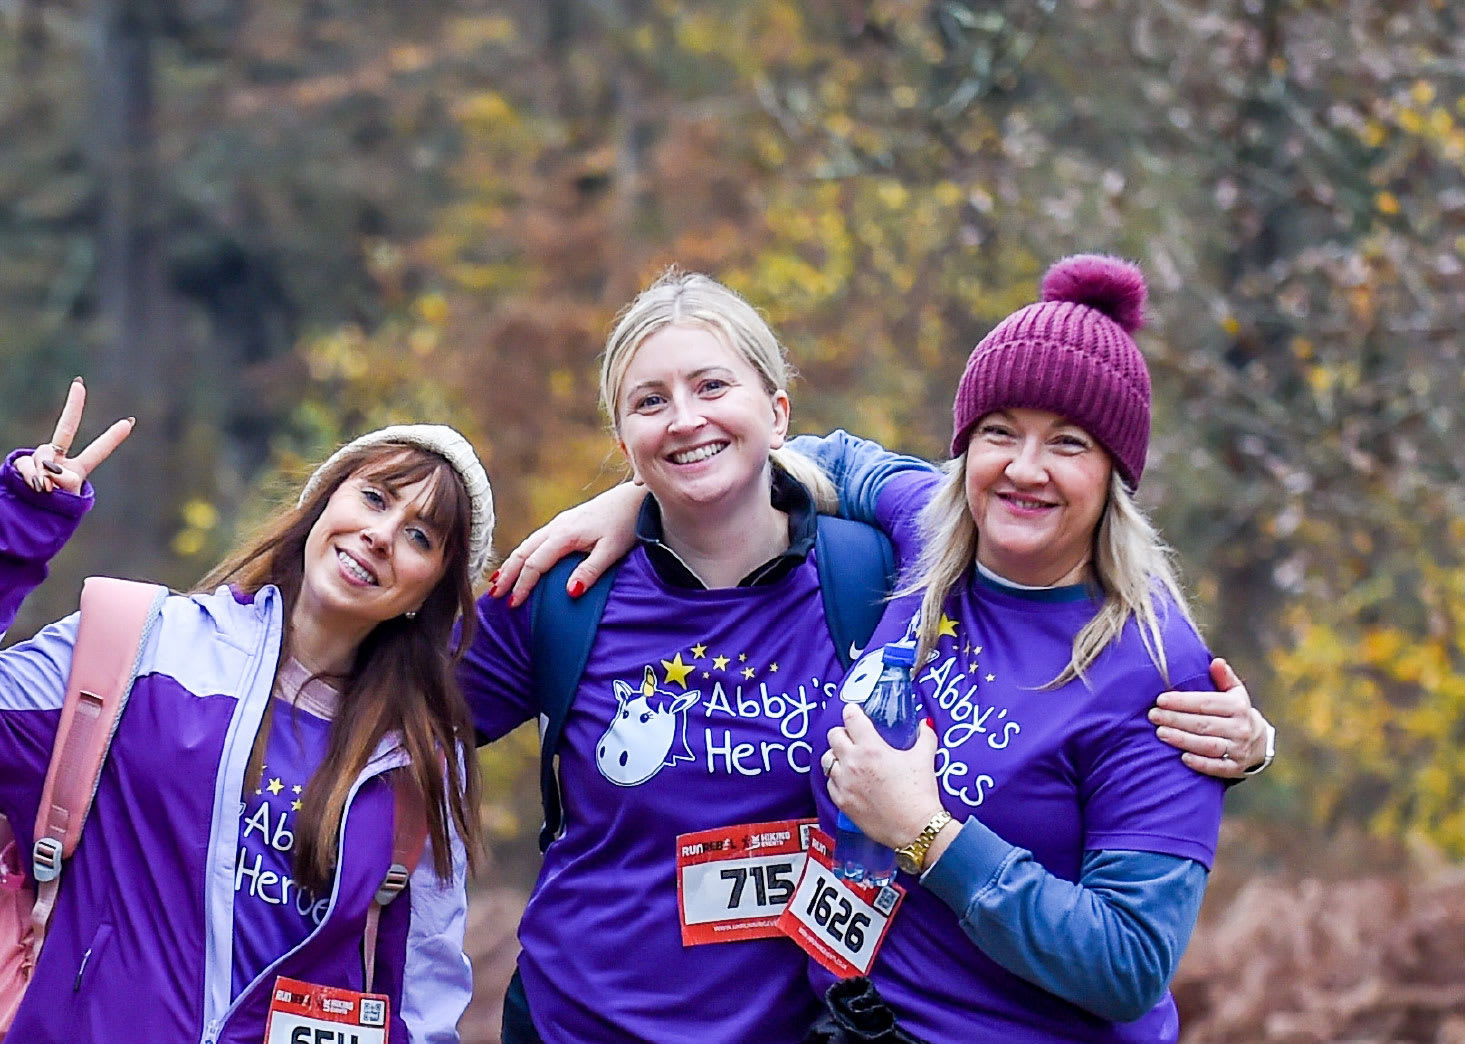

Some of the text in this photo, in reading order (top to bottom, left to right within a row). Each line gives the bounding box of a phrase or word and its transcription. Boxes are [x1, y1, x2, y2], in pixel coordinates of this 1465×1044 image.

[919, 656, 1021, 748] Abby's
[704, 728, 813, 776] Hero
[935, 747, 994, 807] oes
[234, 846, 331, 926] Heroe
[720, 862, 796, 910] 715
[806, 875, 872, 954] 1626
